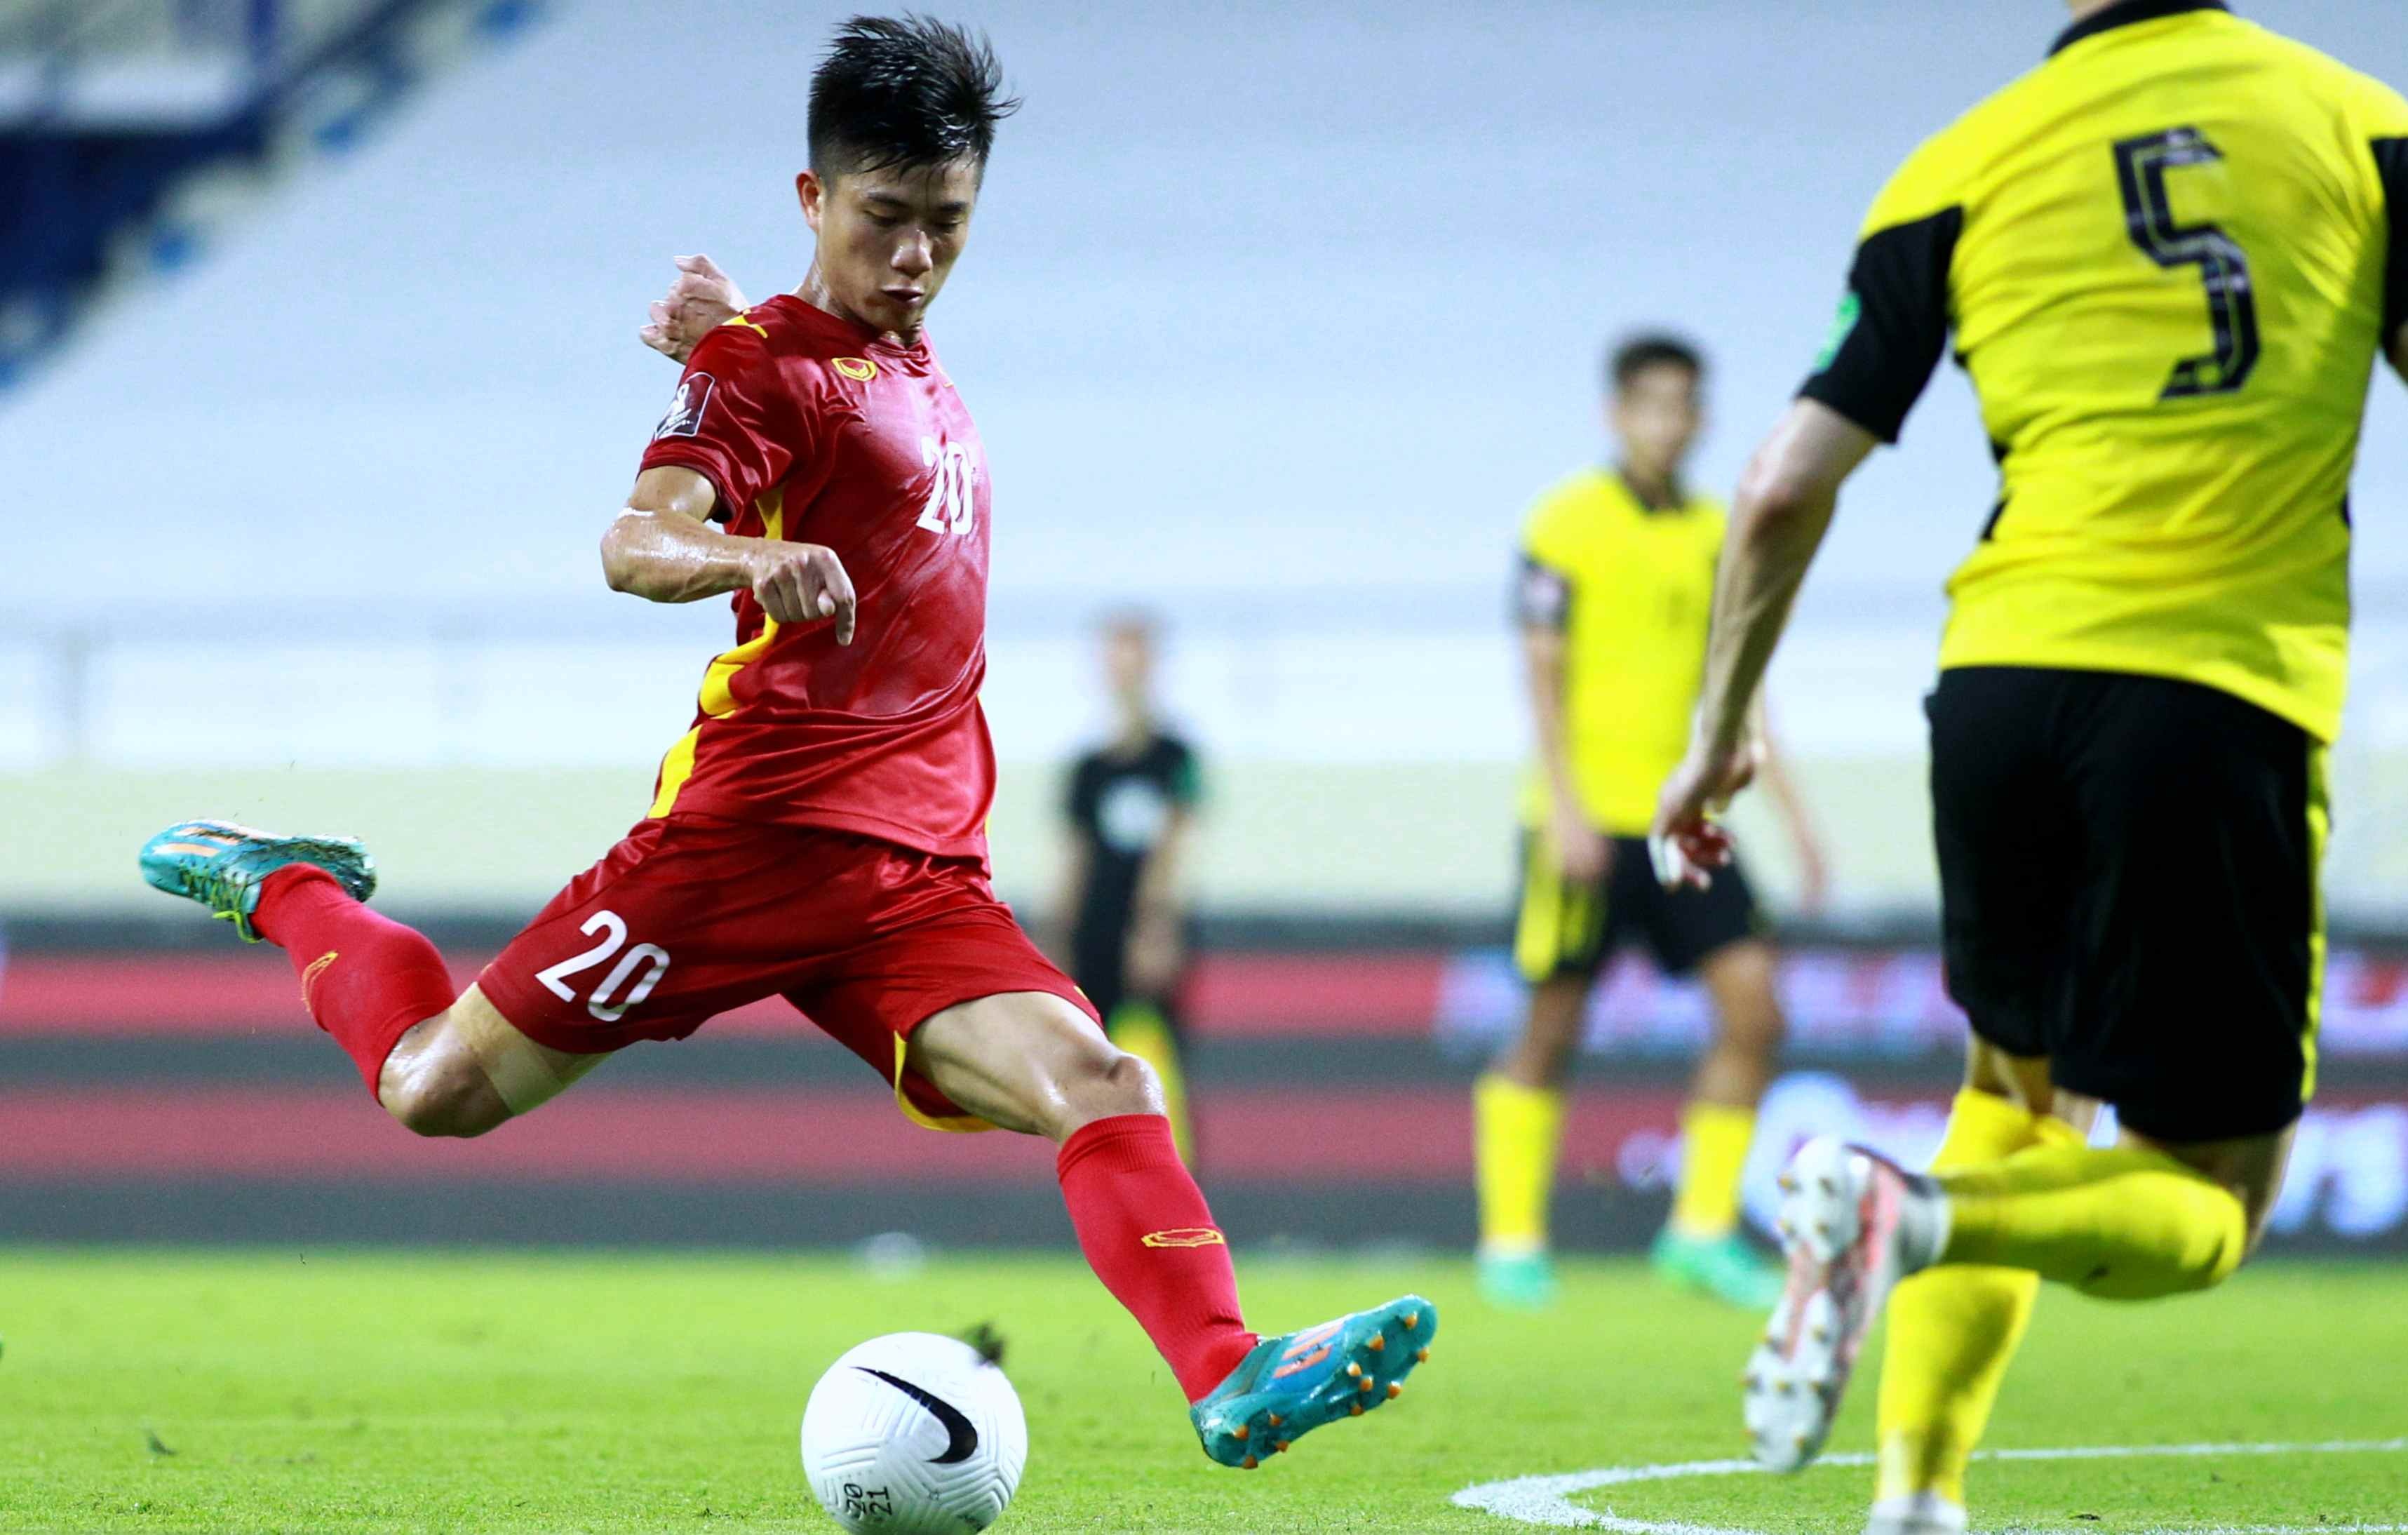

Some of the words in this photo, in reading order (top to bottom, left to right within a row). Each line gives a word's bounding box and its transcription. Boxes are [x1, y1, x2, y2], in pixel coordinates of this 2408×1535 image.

[2112, 125, 2259, 401] 5
[915, 436, 974, 535] 20
[534, 909, 670, 1021] 20
[866, 1486, 893, 1515] 21
